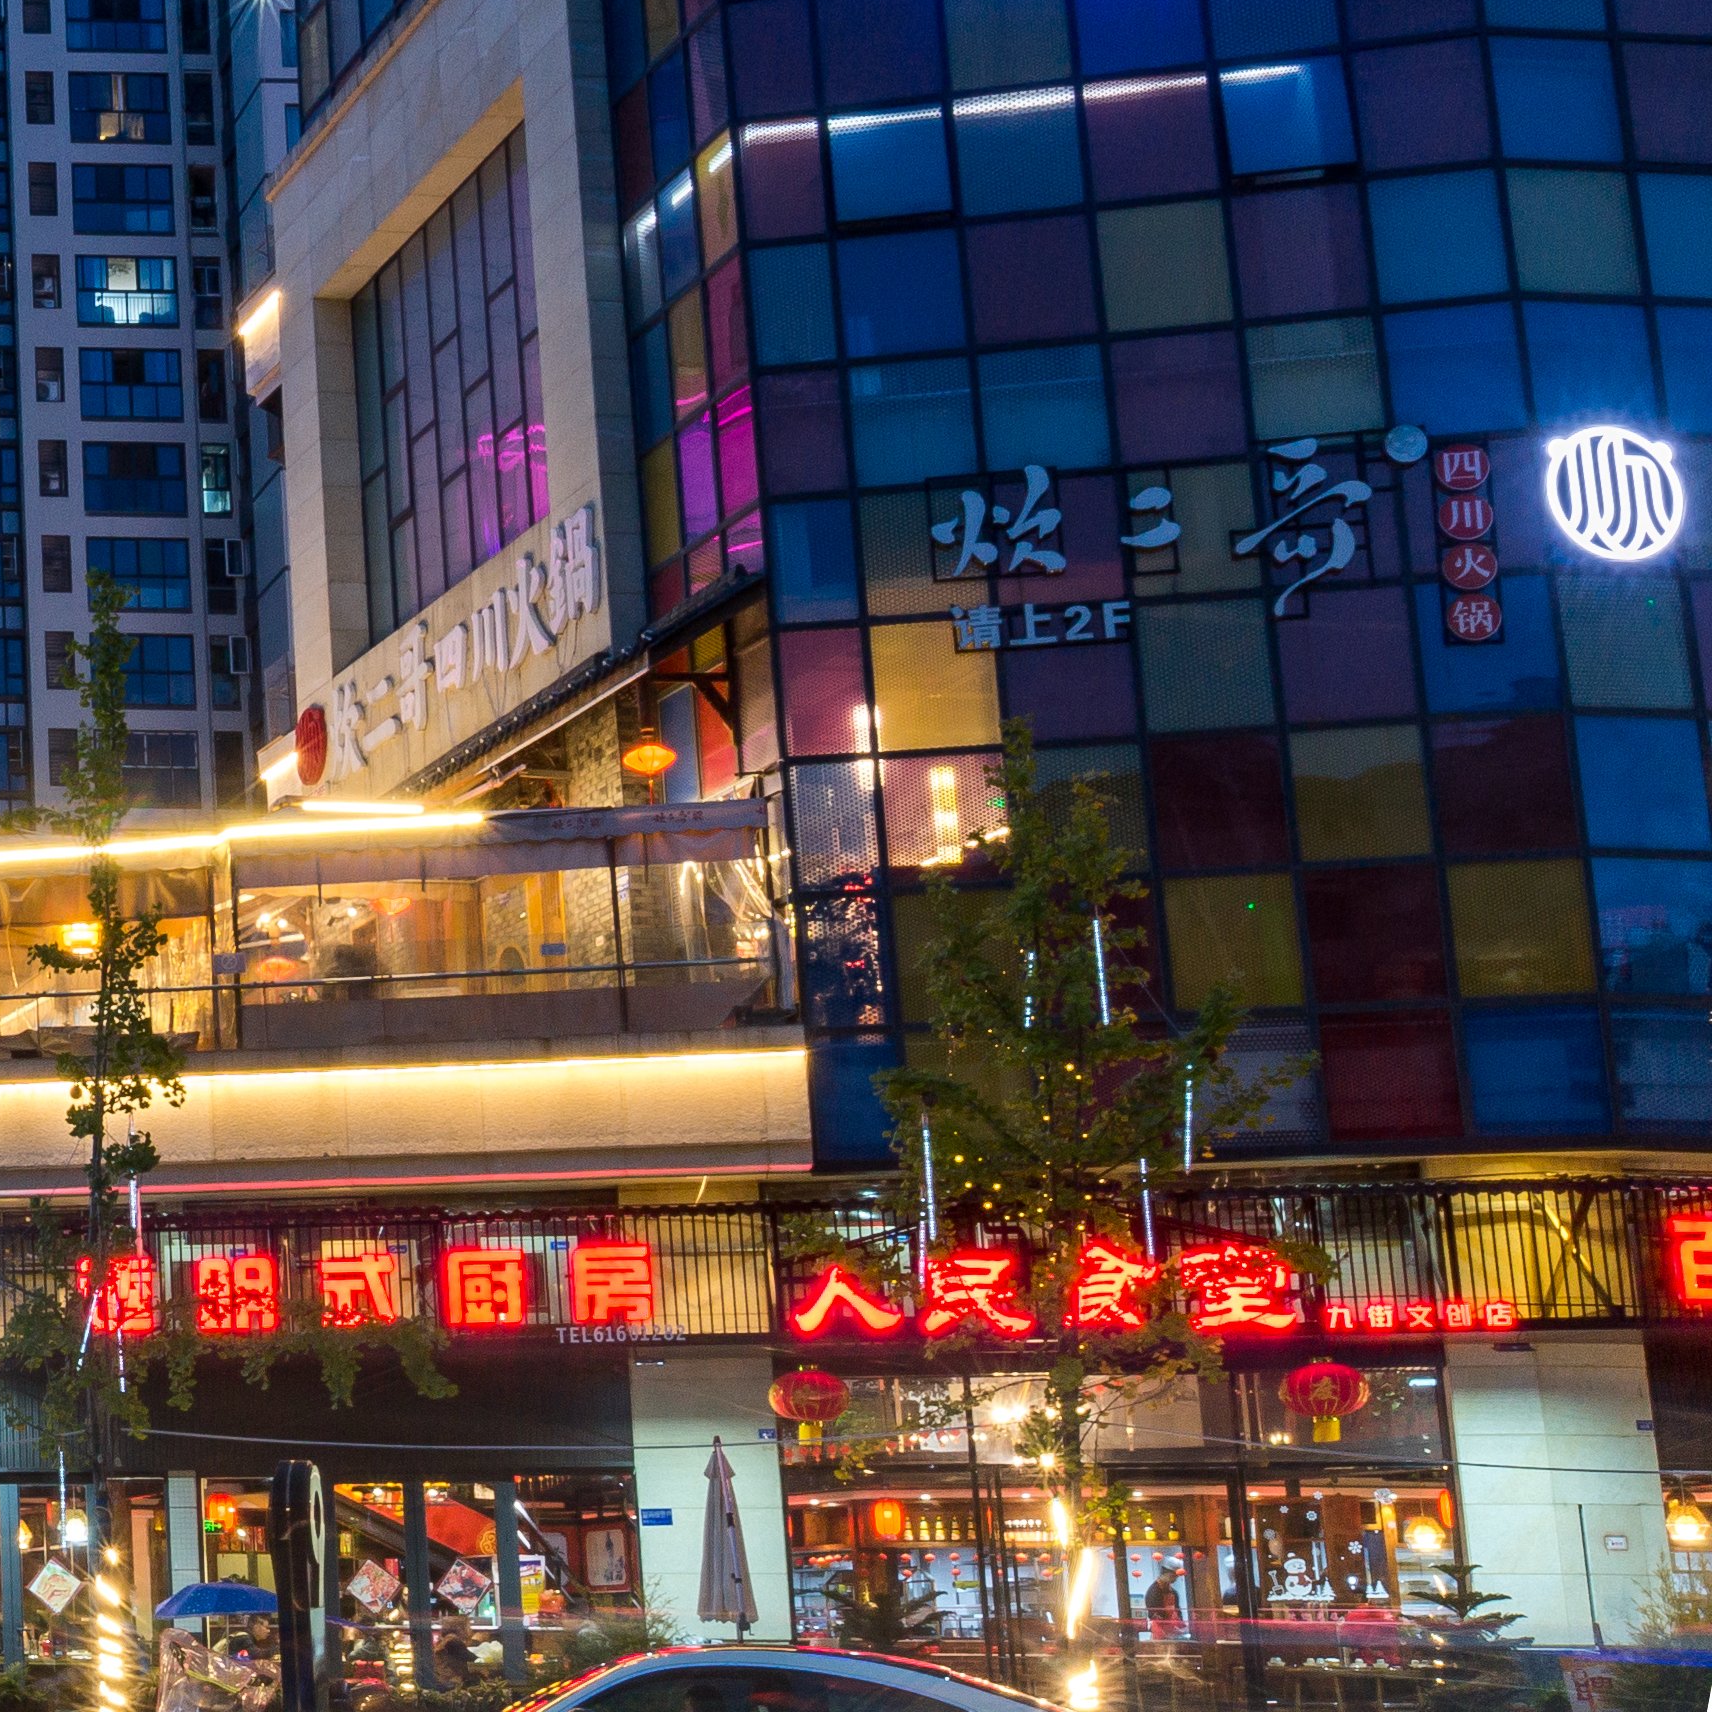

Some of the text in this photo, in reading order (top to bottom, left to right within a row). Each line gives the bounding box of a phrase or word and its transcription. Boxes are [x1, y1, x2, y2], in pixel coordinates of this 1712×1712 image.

[1442, 449, 1493, 634] 四川火锅
[950, 601, 1130, 650] 请上2F
[795, 1244, 1297, 1332] 人民食堂
[1326, 1302, 1513, 1329] 九街文创店
